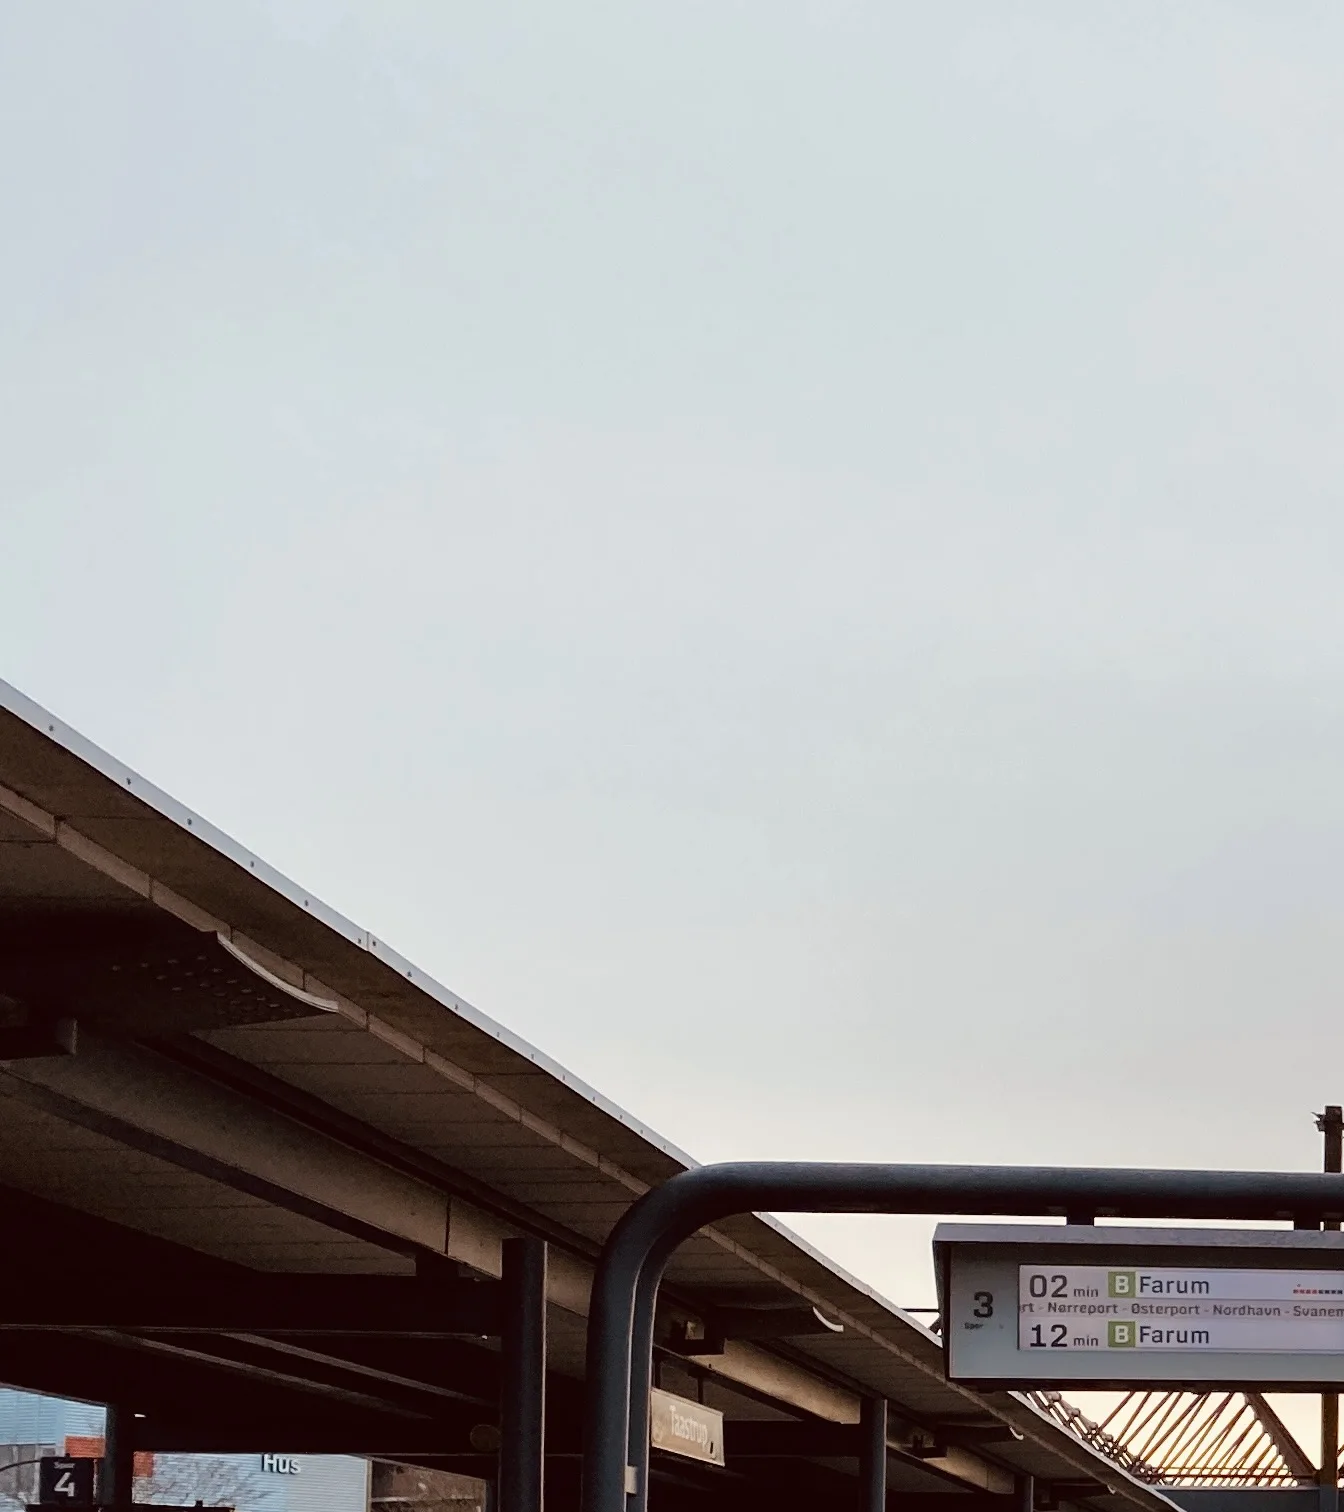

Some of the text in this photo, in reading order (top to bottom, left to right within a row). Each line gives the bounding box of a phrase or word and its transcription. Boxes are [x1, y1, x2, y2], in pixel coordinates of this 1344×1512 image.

[1029, 1274, 1209, 1298] 02 min B Farum
[973, 1291, 994, 1319] 3
[1213, 1304, 1281, 1317] Nordhavn
[1030, 1324, 1209, 1348] 12 min B Farum
[262, 1454, 301, 1476] Hus
[53, 1471, 76, 1498] 4
